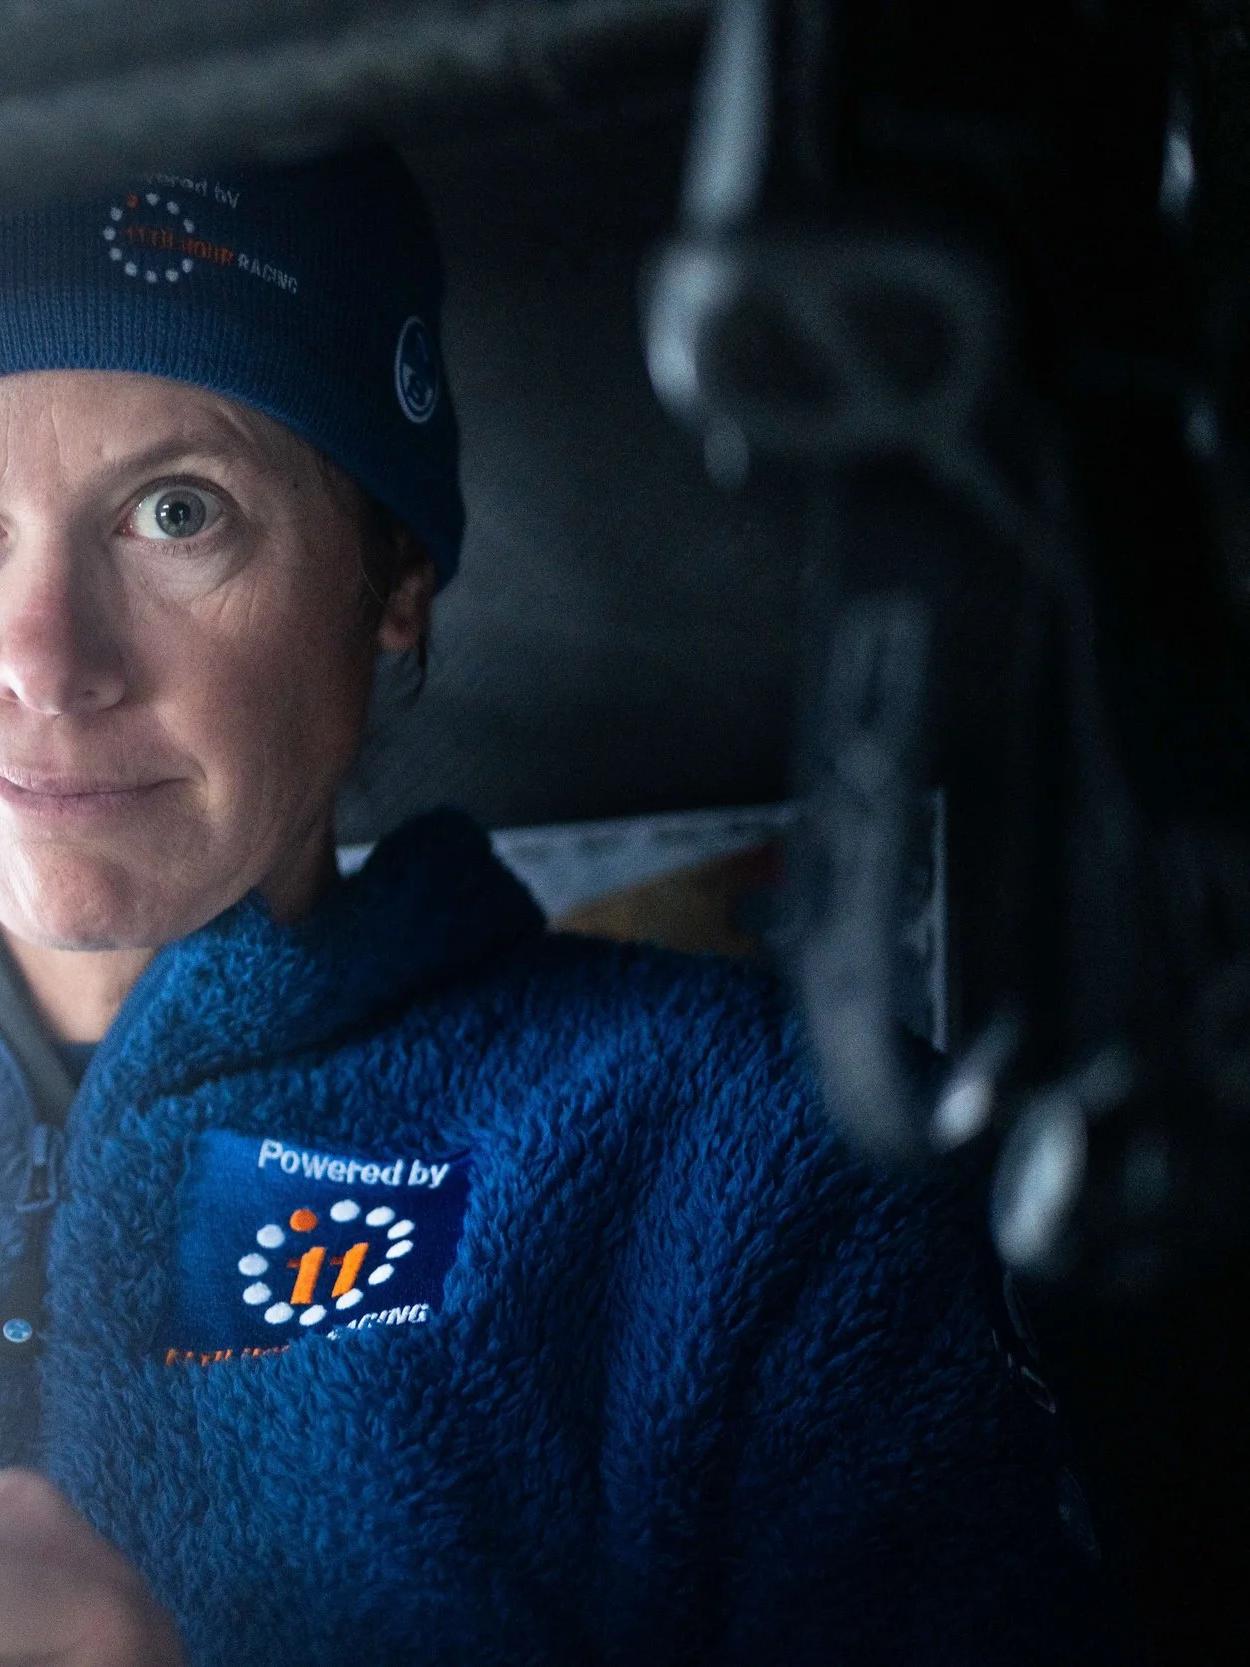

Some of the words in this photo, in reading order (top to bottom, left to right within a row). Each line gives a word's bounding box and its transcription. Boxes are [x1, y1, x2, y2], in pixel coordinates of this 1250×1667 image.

[237, 253, 299, 294] RACING
[257, 1137, 403, 1187] Powered
[407, 1158, 451, 1190] by
